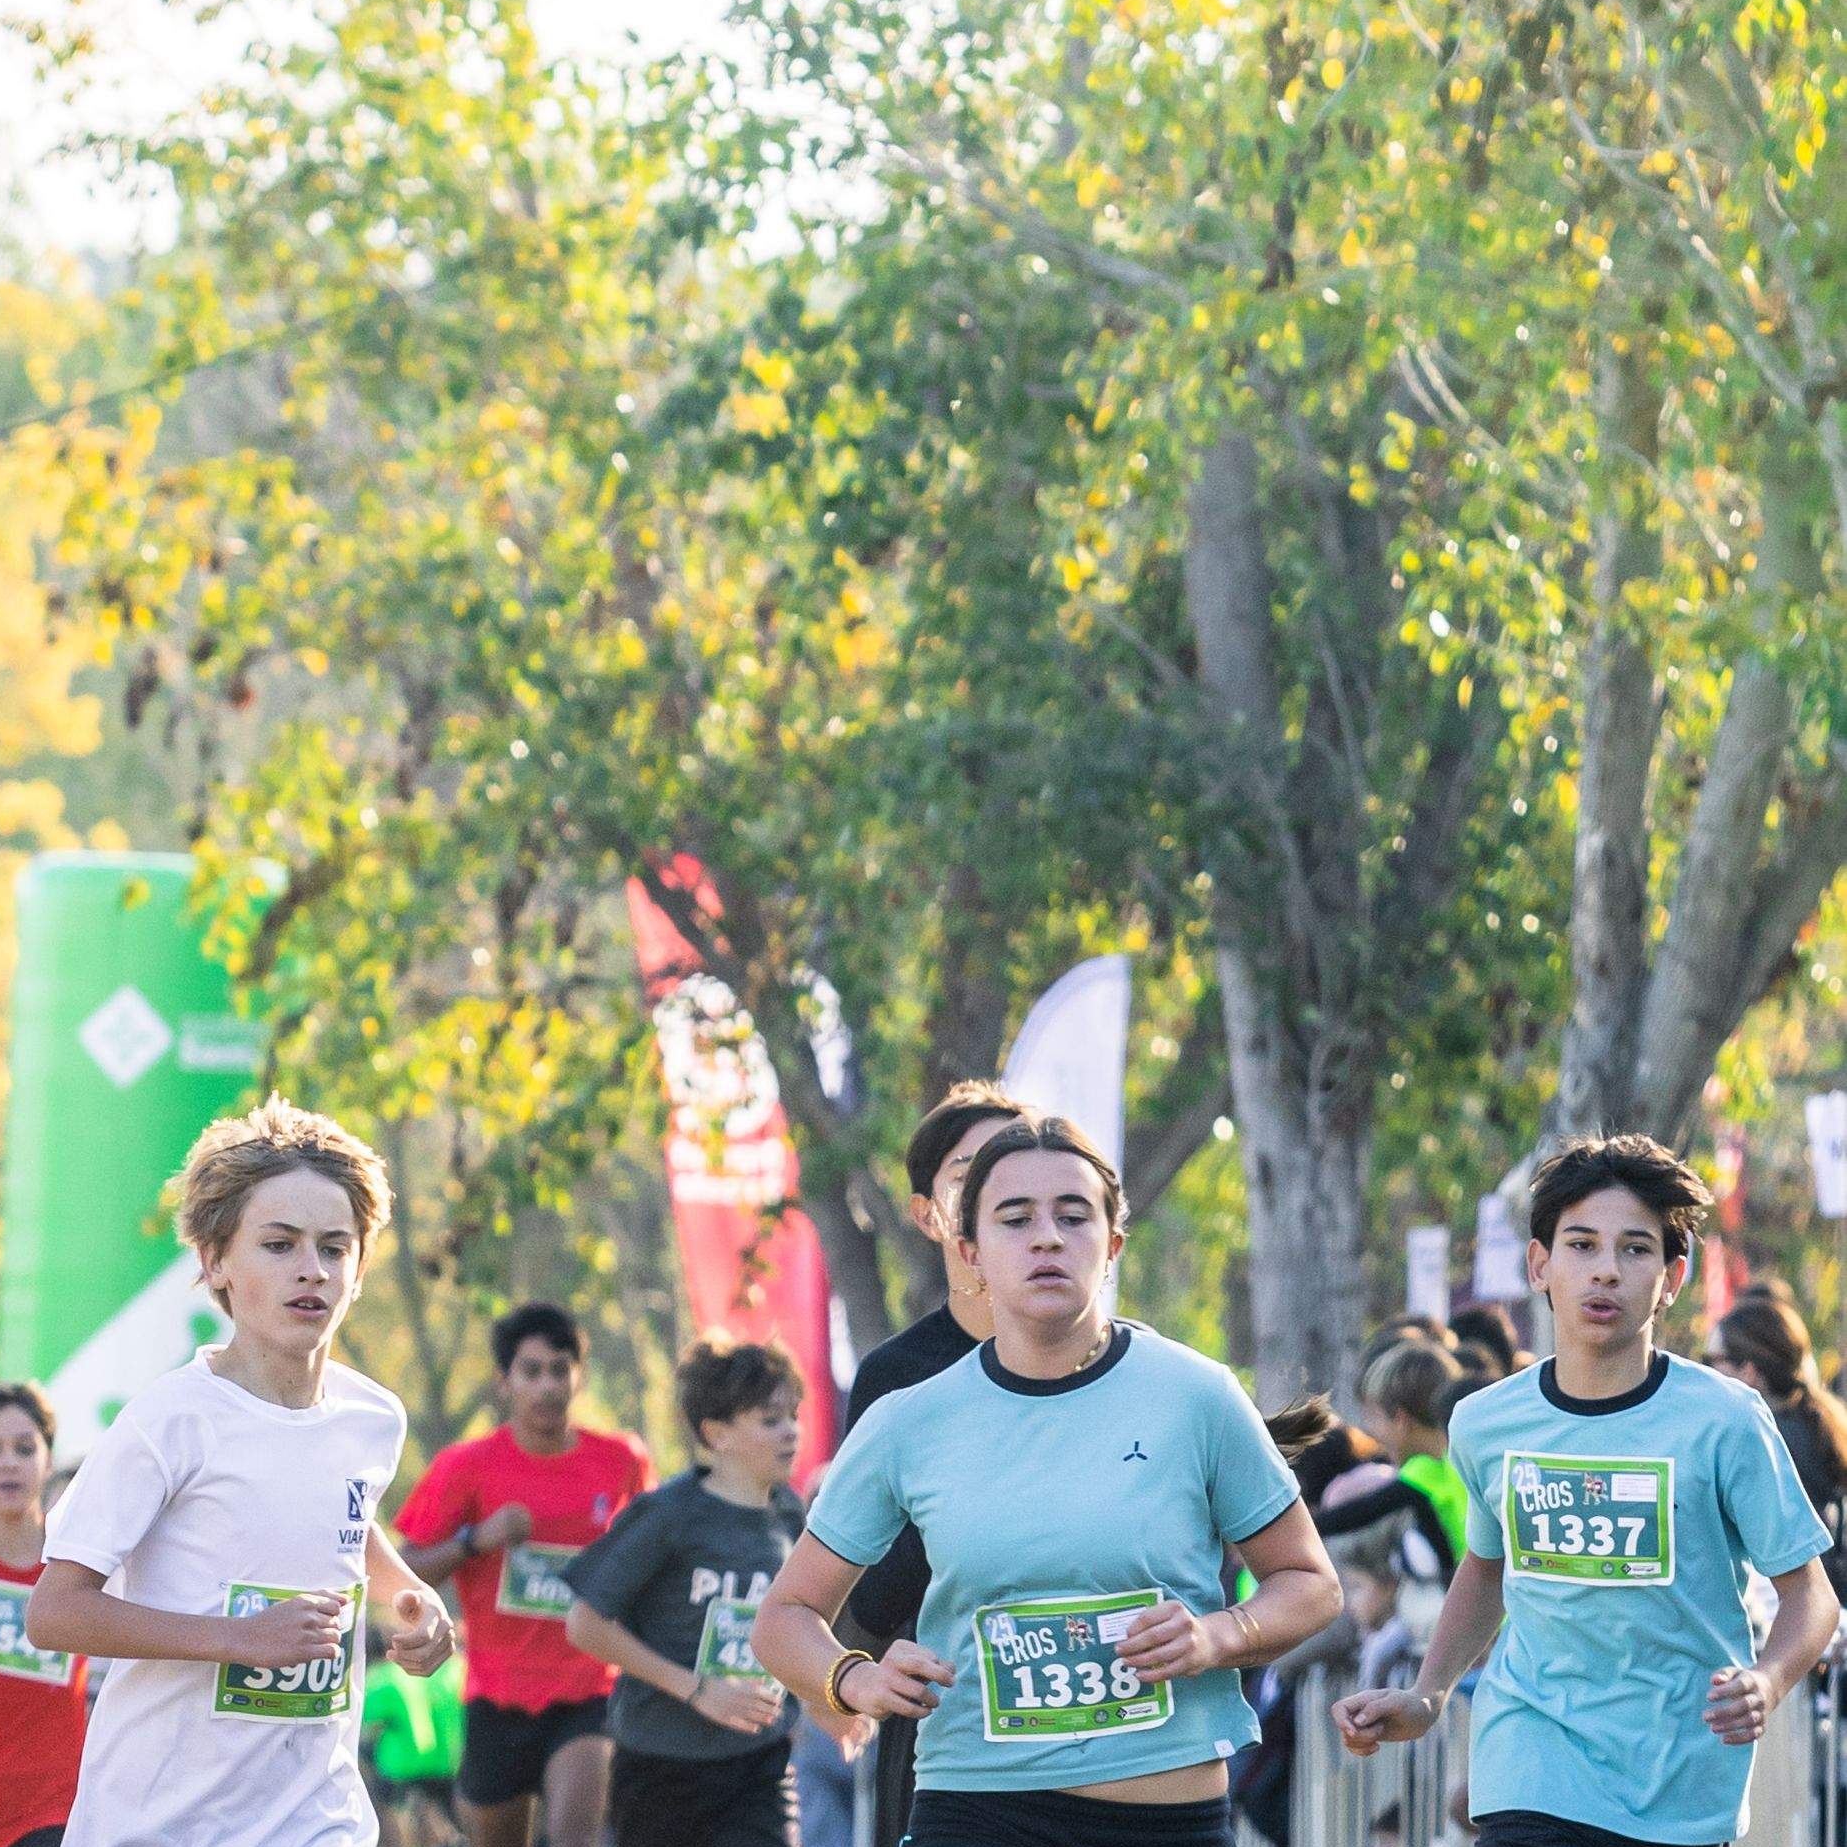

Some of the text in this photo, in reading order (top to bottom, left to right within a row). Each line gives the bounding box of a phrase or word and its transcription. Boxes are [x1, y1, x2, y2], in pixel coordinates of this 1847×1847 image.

[1521, 1480, 1575, 1513] CROS
[1531, 1513, 1647, 1557] 1337
[998, 1627, 1058, 1666] CROS
[1013, 1657, 1141, 1709] 1338
